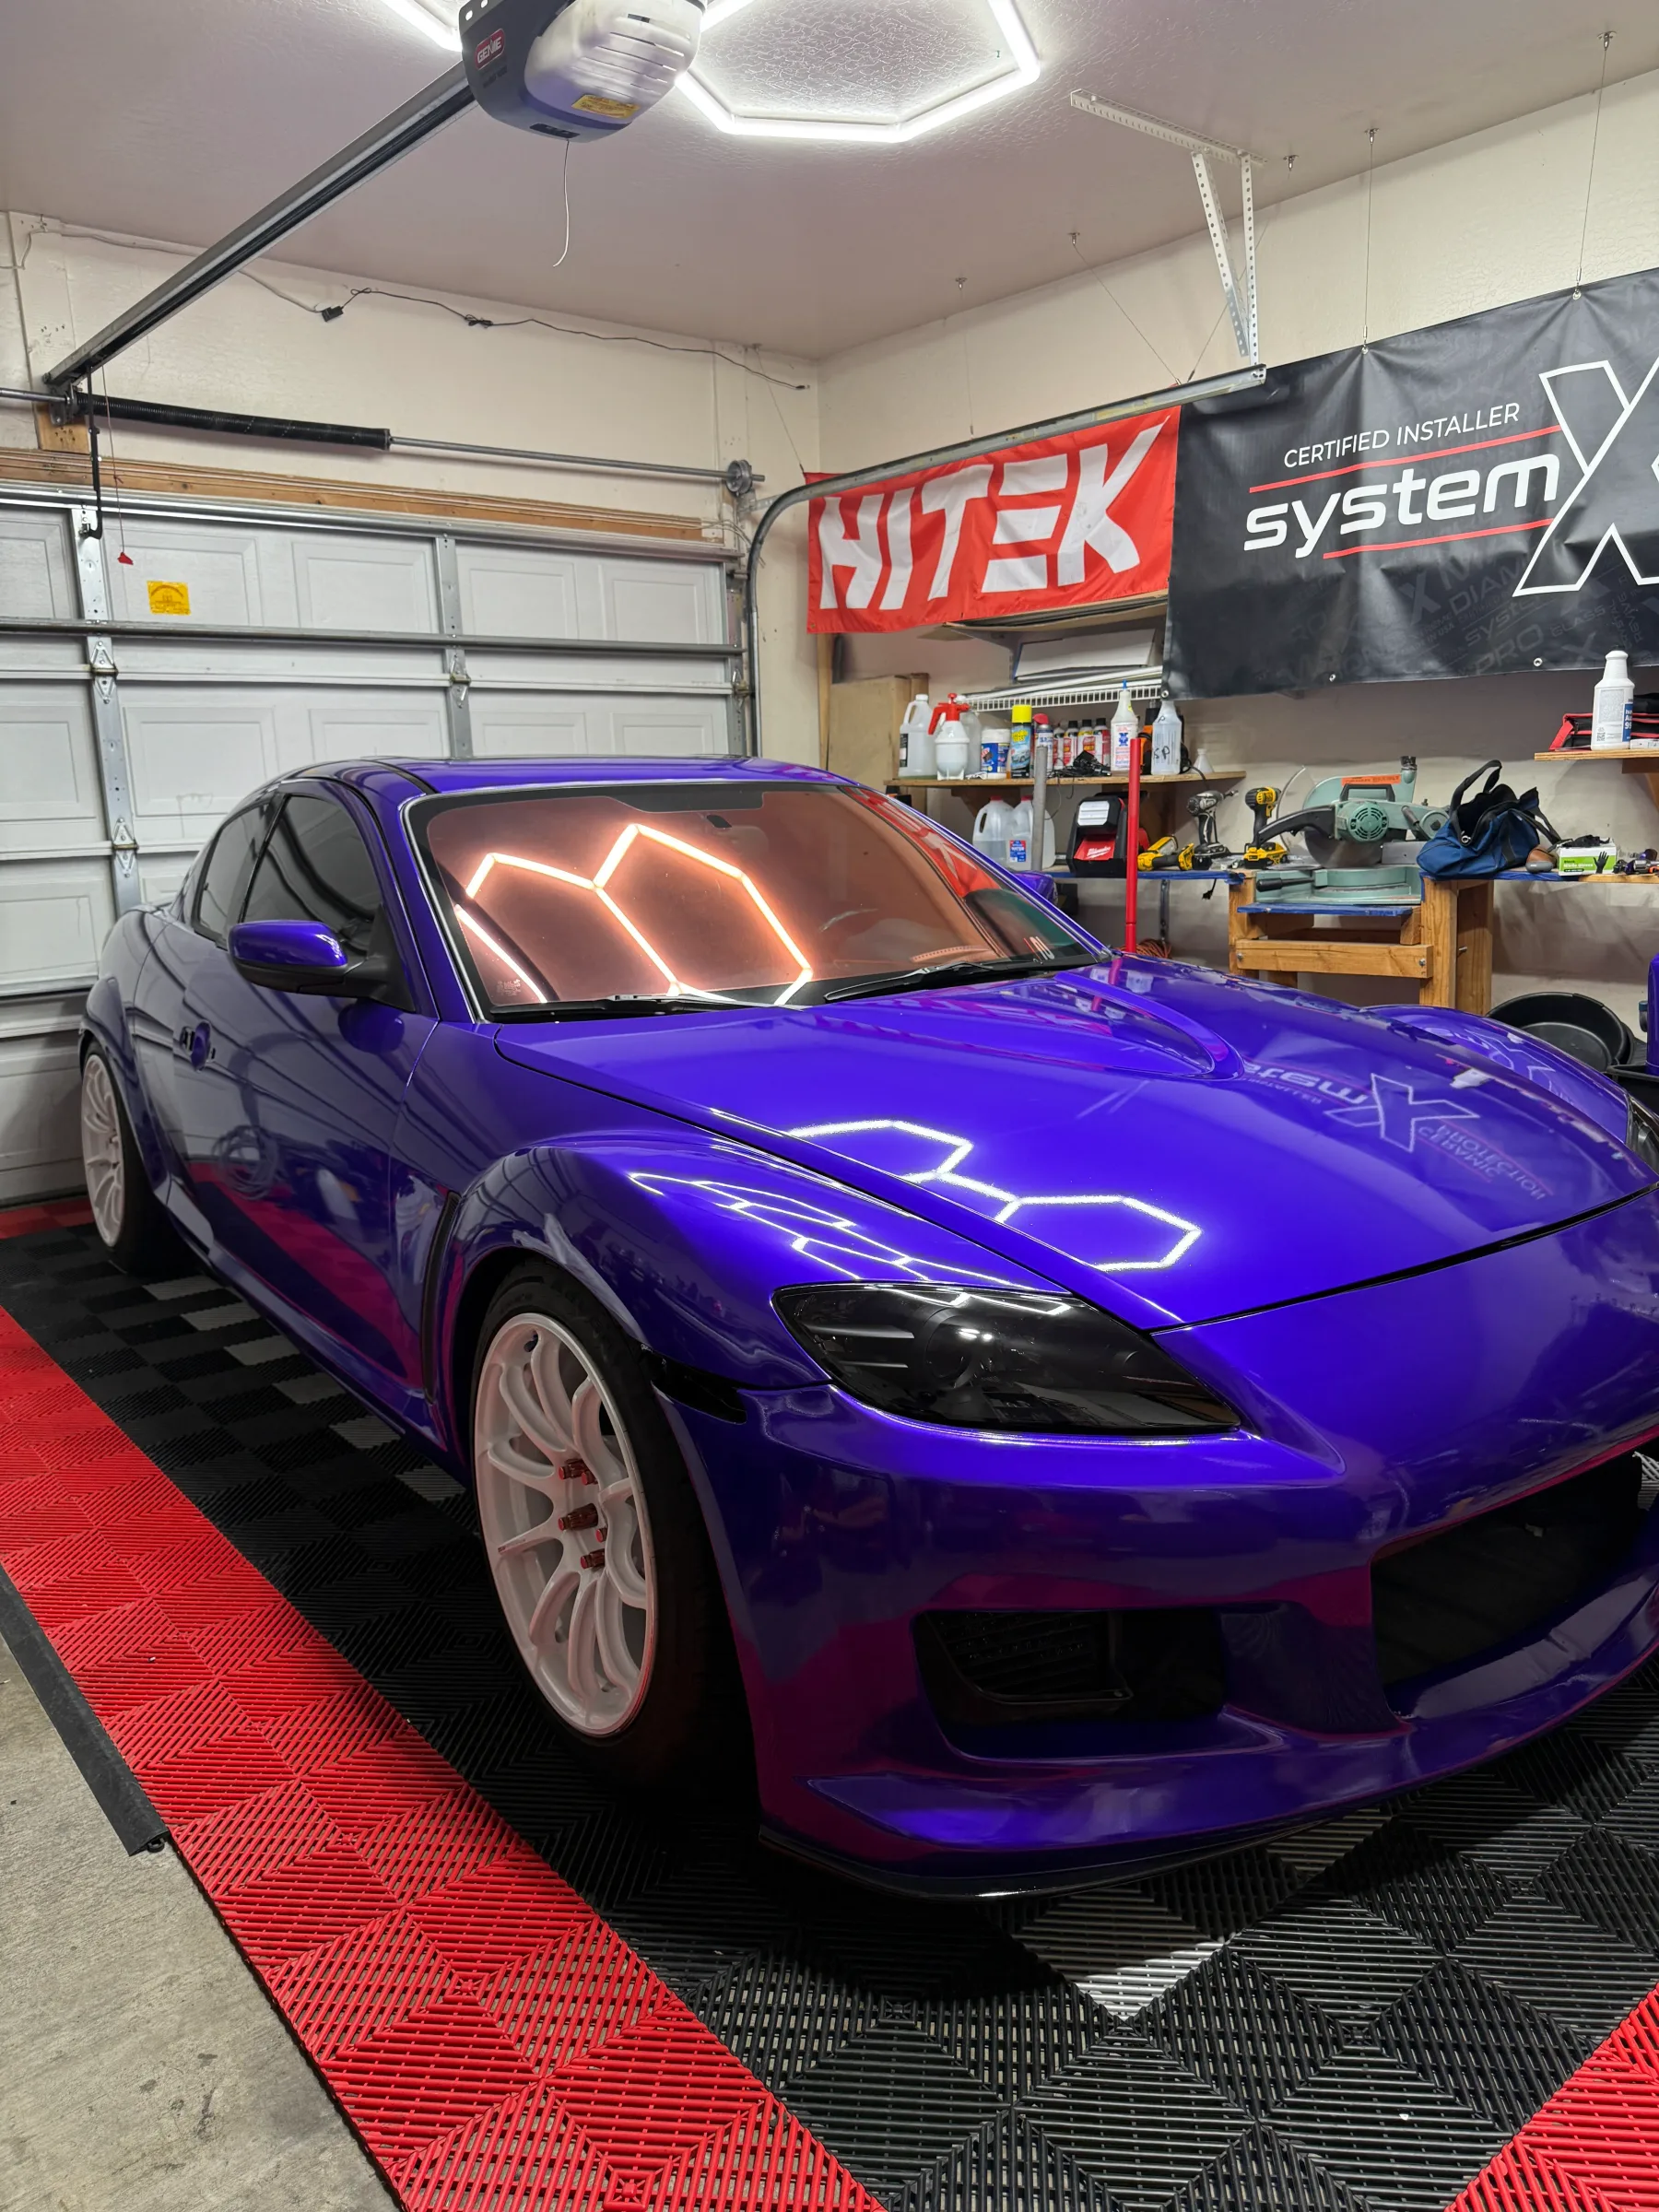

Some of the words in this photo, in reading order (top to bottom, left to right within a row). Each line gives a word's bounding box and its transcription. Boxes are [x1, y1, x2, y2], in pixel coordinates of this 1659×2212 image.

[477, 36, 502, 64] GENIE
[1284, 429, 1390, 468] CERTIFIED
[1396, 402, 1521, 446] INSTALLER
[818, 415, 1171, 610] HITEK
